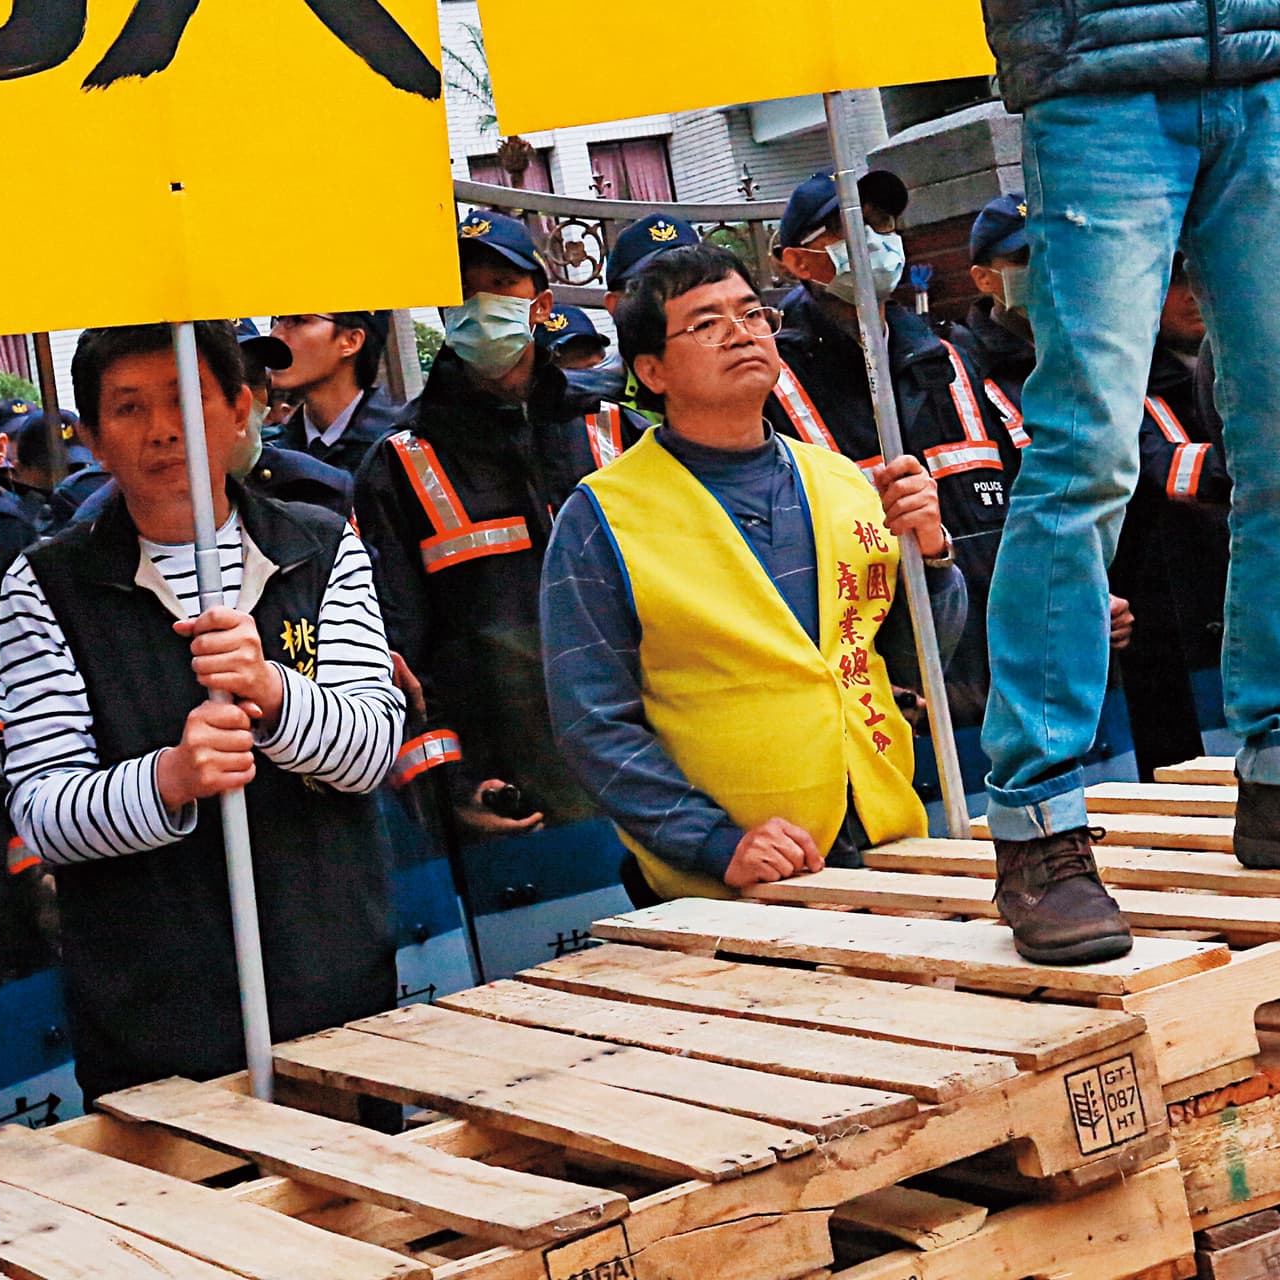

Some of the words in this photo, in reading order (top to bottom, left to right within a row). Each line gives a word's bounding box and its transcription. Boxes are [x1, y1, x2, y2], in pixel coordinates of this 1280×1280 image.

[973, 481, 1003, 493] POLICE
[1107, 1085, 1135, 1112] 087
[1117, 1111, 1136, 1131] HT
